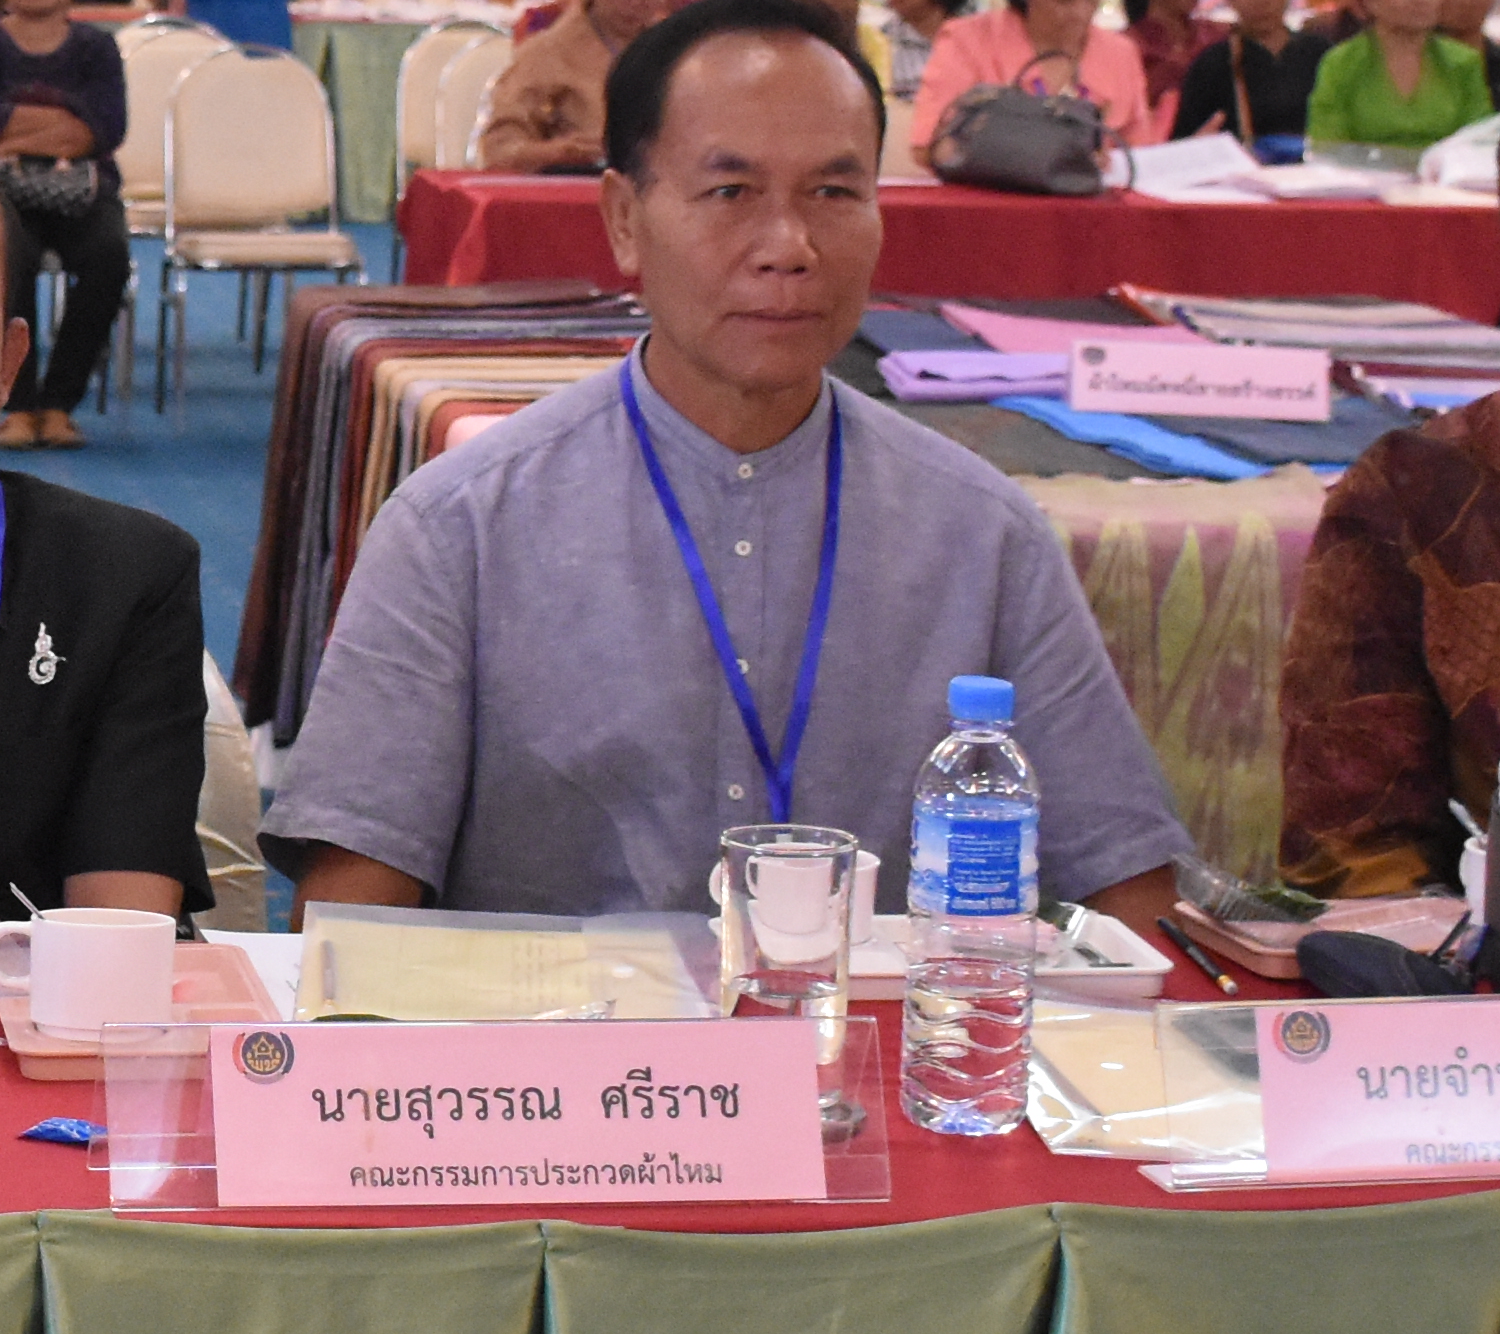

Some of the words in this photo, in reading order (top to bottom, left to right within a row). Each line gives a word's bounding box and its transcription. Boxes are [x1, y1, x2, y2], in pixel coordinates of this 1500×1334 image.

[311, 1085, 563, 1140] นายสุวรรณ
[600, 1066, 740, 1120] ศรีราช
[349, 1152, 723, 1188] คณะกรรมการประกวดผ้าไหม
